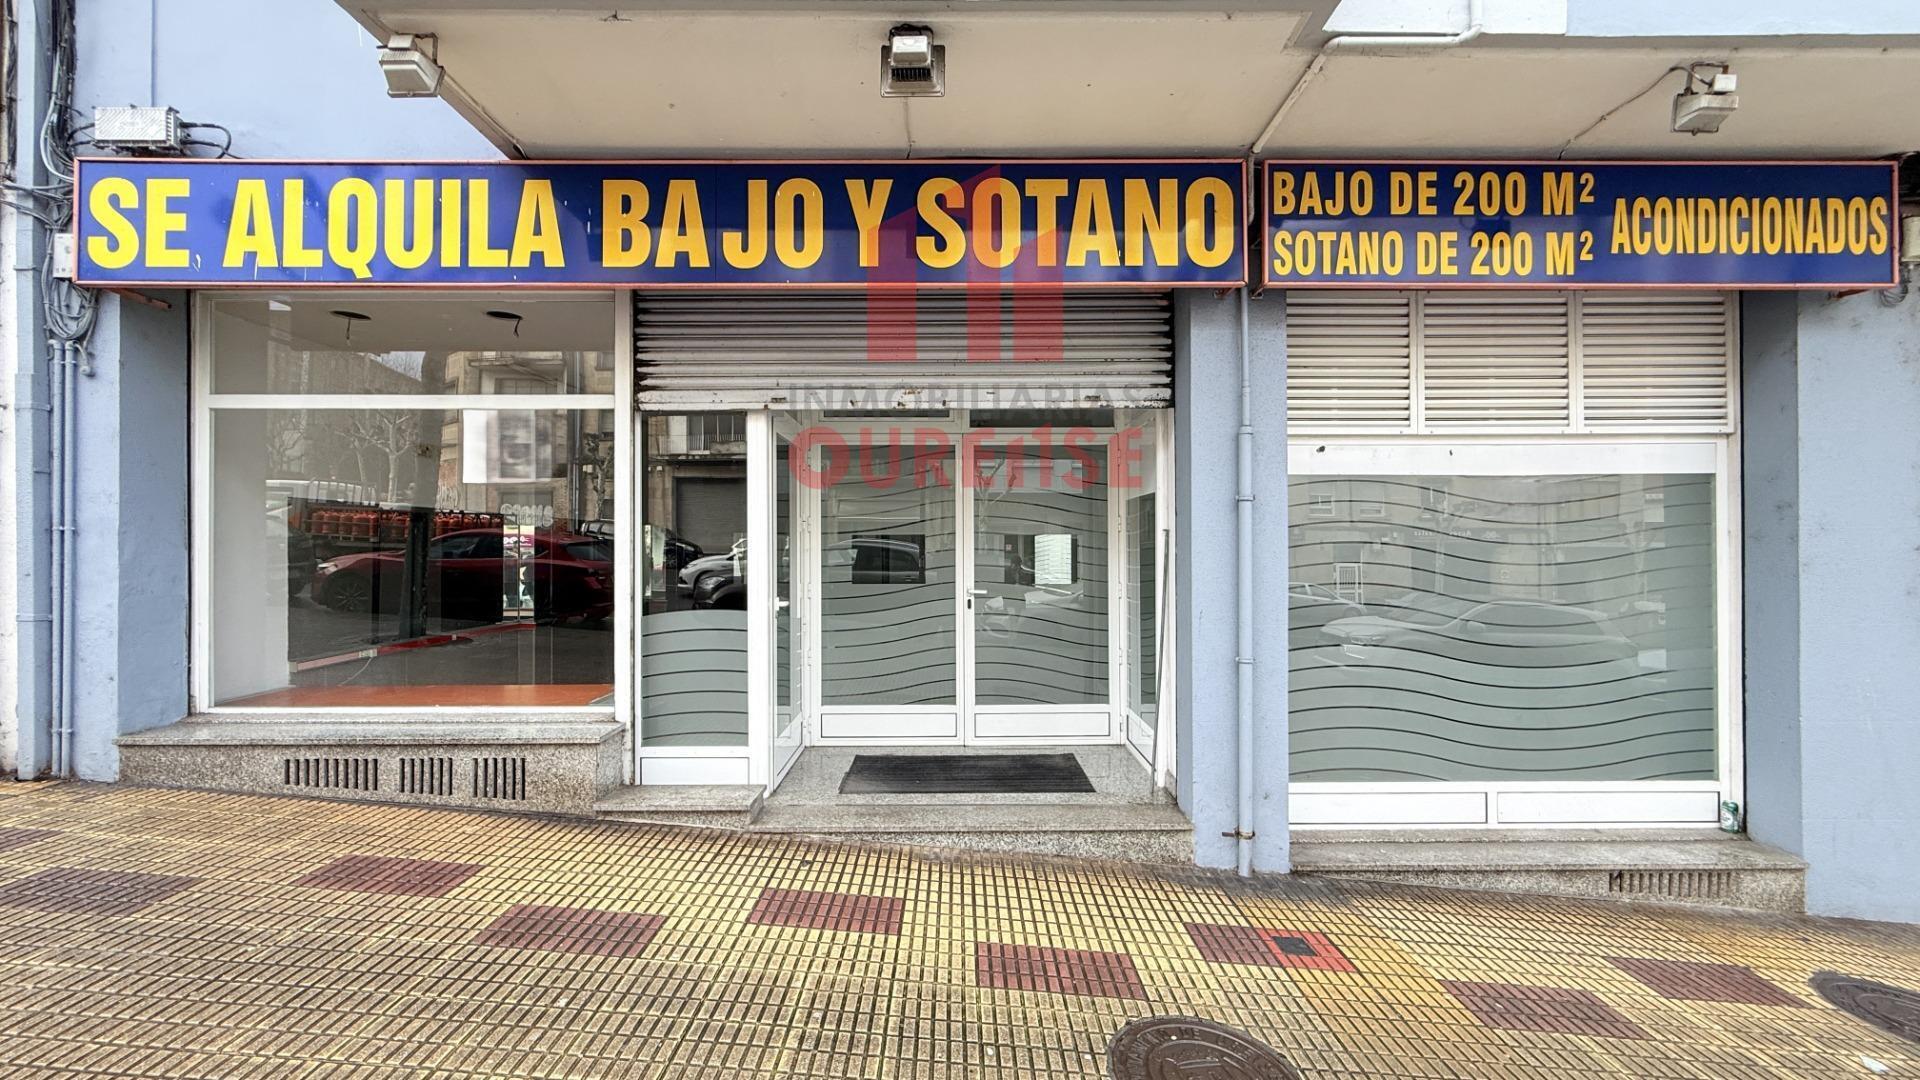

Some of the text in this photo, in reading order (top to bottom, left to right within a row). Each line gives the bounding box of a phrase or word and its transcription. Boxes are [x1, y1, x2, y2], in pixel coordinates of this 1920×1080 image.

[1273, 171, 1373, 216] BAJO
[1390, 171, 1437, 216] DE
[1453, 171, 1526, 216] 200
[87, 177, 1235, 279] SE ALQUILA BAJO Y SOTANO
[1611, 196, 1888, 256] ACONDICIONADOS
[1273, 230, 1403, 276] SOTANO
[1416, 231, 1459, 276] DE
[1470, 230, 1533, 276] 200
